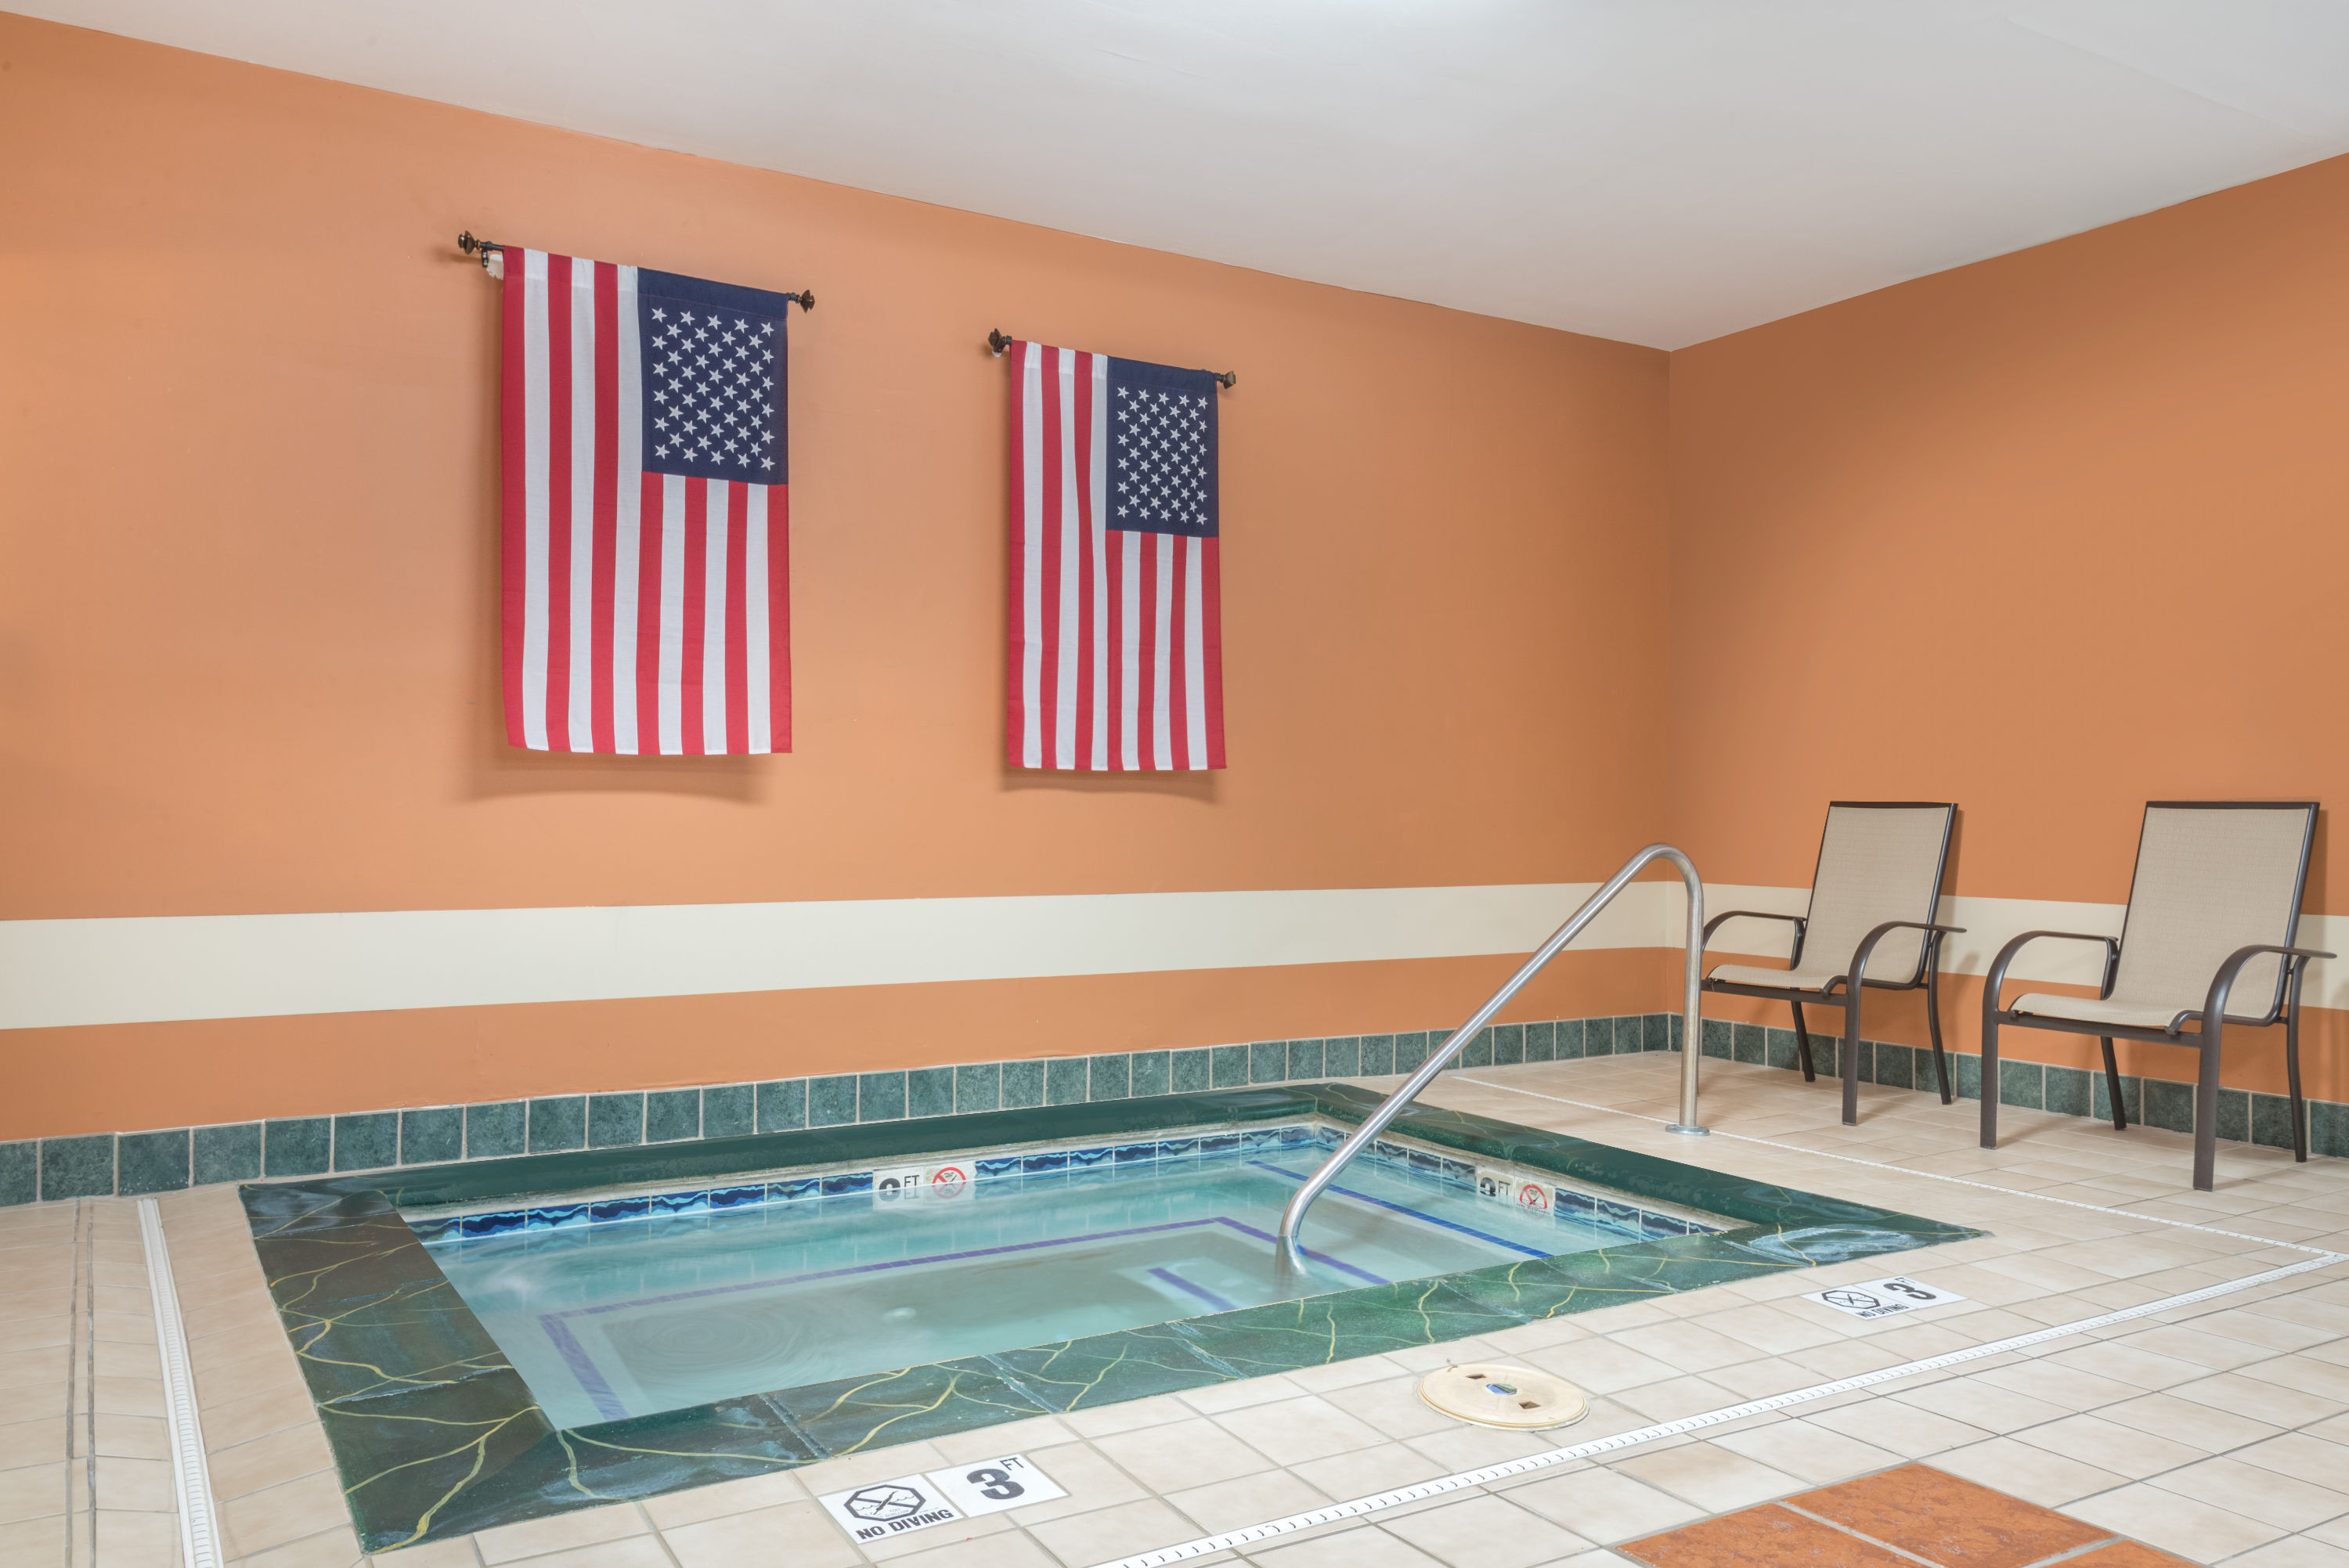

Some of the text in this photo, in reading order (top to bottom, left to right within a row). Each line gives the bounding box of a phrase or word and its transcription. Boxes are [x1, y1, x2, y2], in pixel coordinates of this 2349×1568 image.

[904, 1174, 920, 1188] FT
[1498, 1180, 1510, 1196] FT
[1883, 1282, 1937, 1300] 3
[1871, 1303, 1910, 1315] DIVING
[1000, 1457, 1024, 1471] FT
[966, 1468, 1025, 1500] 3
[856, 1526, 886, 1540] NO
[888, 1509, 954, 1532] DIVING
